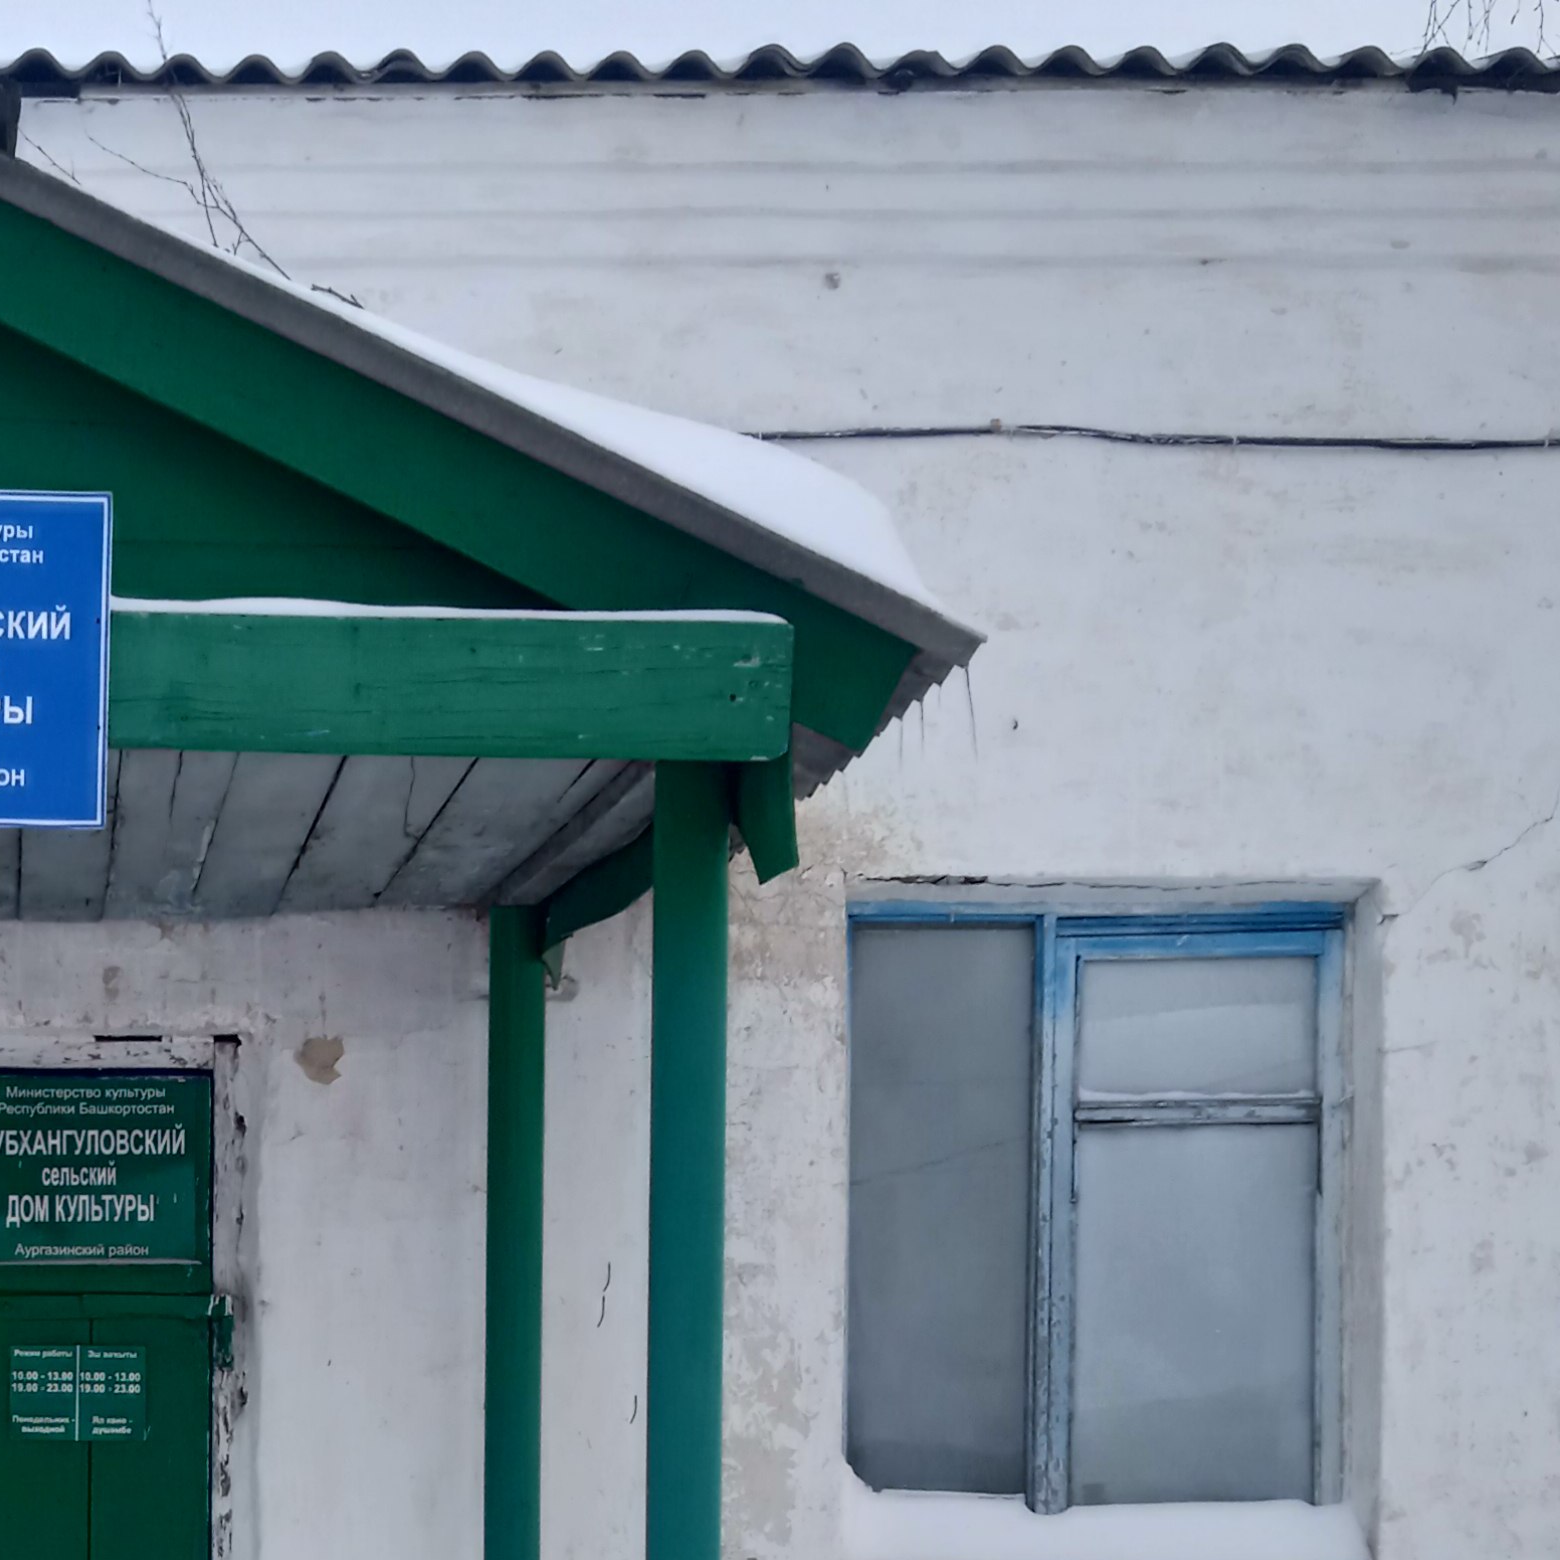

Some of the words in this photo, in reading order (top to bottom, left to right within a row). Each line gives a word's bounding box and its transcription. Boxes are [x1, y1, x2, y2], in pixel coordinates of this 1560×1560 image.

[6, 1086, 101, 1100] Министерство
[105, 1088, 165, 1099] культуры
[79, 1103, 174, 1116] Башкортостан
[42, 1161, 116, 1186] сельский
[6, 1195, 49, 1228] ДОМ
[55, 1194, 154, 1222] КУЛЬТУРЫ
[15, 1243, 104, 1257] Аургазинский
[109, 1244, 149, 1257] район
[14, 1349, 40, 1357] Режим
[42, 1350, 72, 1358] работы
[12, 1371, 38, 1380] 10.00
[47, 1371, 73, 1380] 13.00
[80, 1372, 105, 1381] 10.00
[115, 1372, 140, 1382] 13.00
[12, 1383, 38, 1392] 19.00
[47, 1383, 73, 1392] 23.00
[80, 1384, 105, 1393] 19.00
[114, 1384, 140, 1393] 23.00
[12, 1415, 69, 1423] Понедельник
